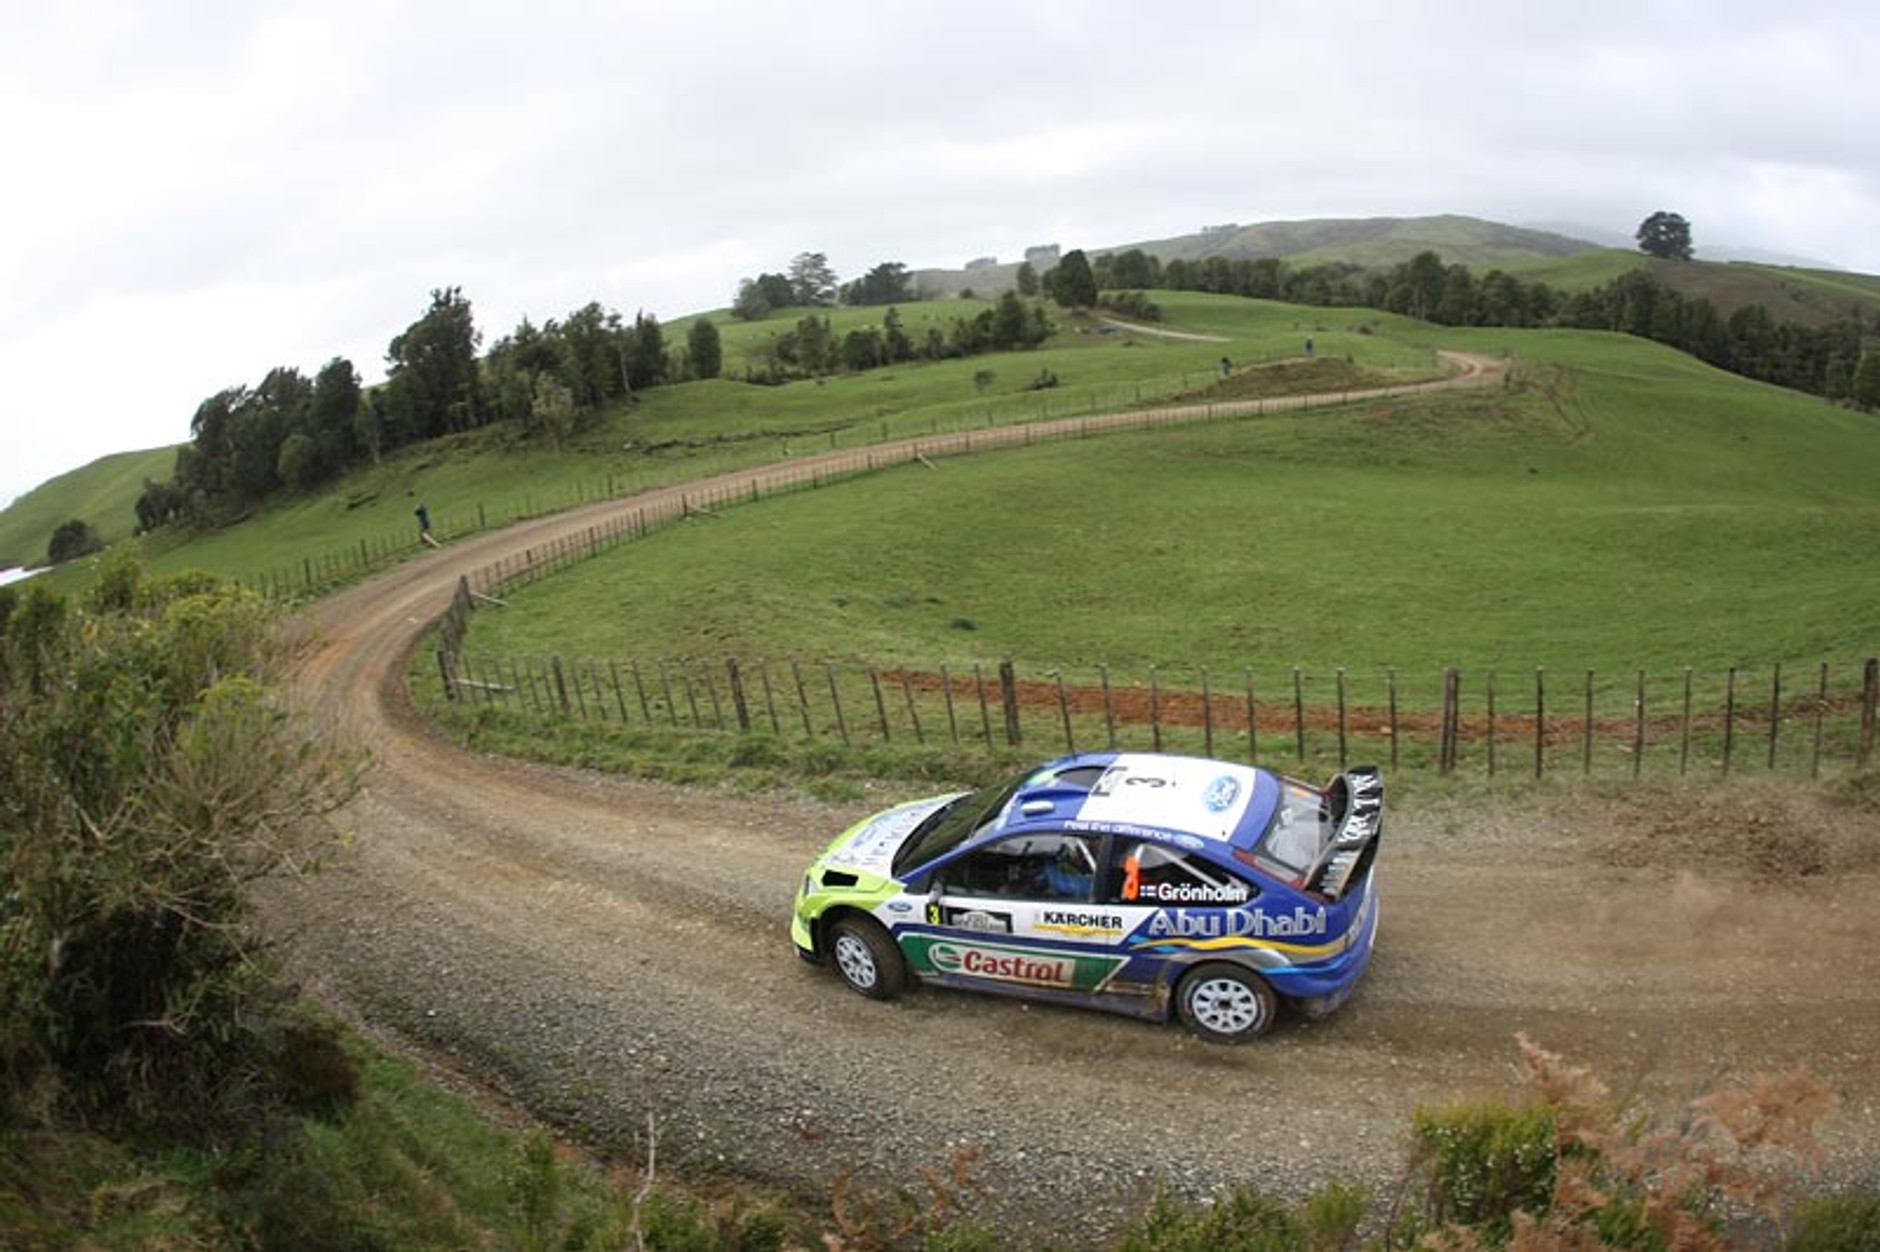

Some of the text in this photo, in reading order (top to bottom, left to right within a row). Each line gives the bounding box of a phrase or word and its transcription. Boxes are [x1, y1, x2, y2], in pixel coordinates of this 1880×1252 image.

[1125, 776, 1166, 788] 3
[1158, 882, 1247, 904] Grönholm
[928, 904, 940, 926] 3
[1148, 907, 1221, 936] Abu
[1225, 905, 1327, 936] Dhabi
[963, 950, 1068, 984] Castrol
